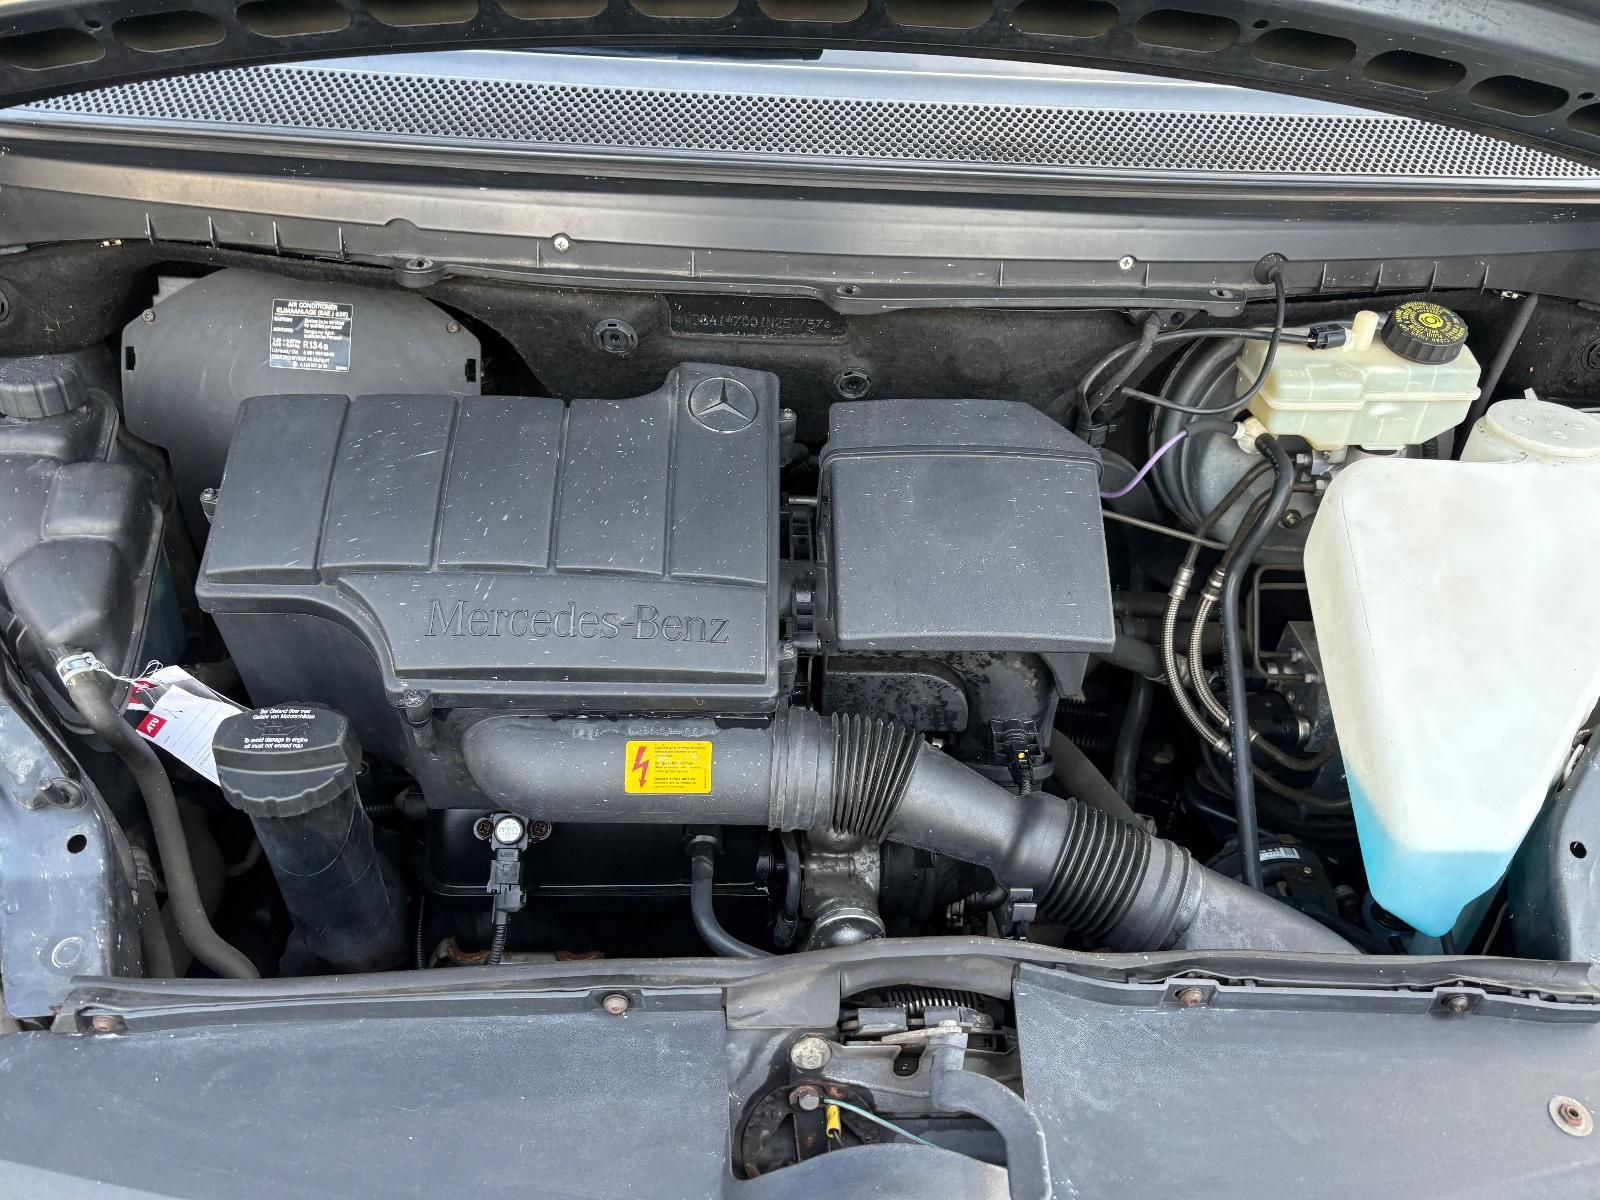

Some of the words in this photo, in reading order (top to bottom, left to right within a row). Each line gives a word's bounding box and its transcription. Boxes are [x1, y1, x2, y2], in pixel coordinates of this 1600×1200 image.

[299, 302, 338, 311] CONDITIONER
[424, 599, 730, 643] Mercedes-Benz
[146, 717, 160, 733] ATU
